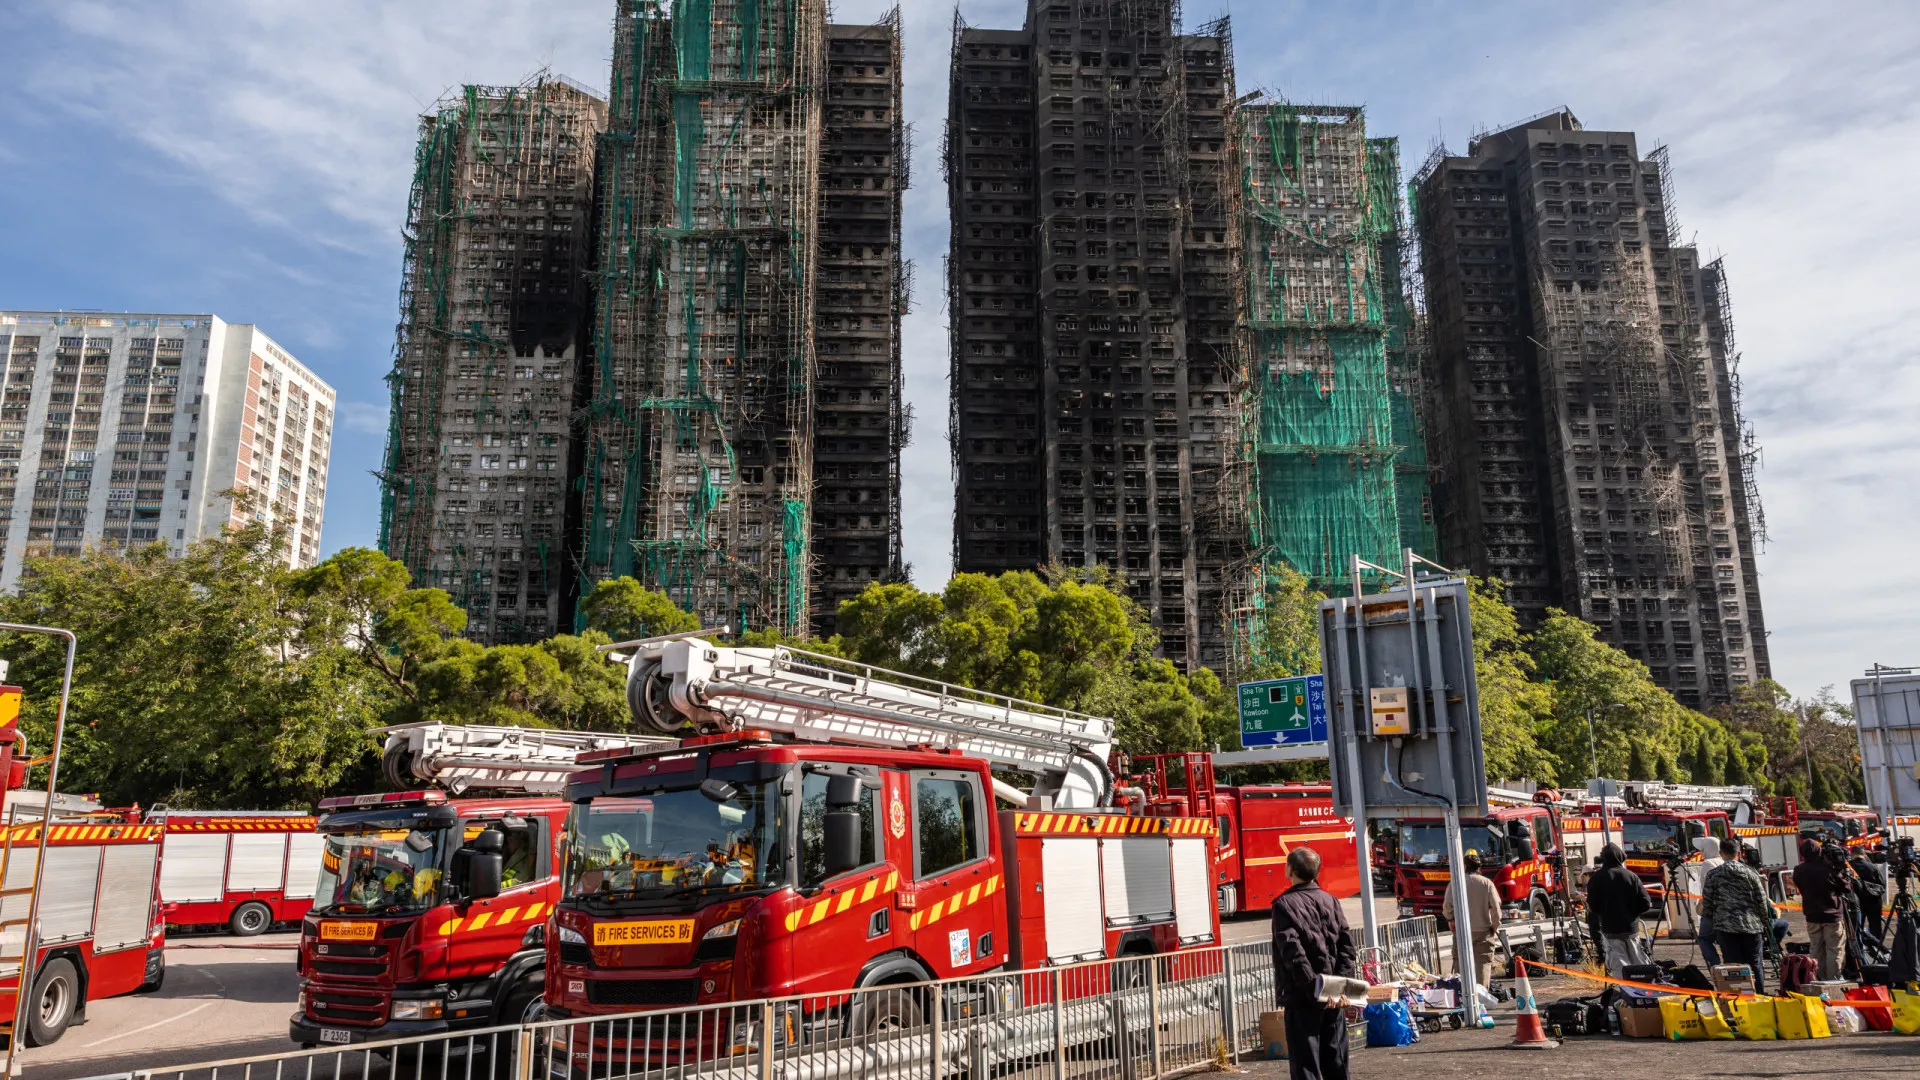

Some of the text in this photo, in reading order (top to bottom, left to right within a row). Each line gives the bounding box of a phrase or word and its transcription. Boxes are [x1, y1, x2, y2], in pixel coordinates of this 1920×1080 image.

[1255, 686, 1264, 694] Tin
[1243, 697, 1260, 708] 沙田
[1312, 703, 1322, 711] Tai
[1243, 708, 1269, 717] Kowloon
[1245, 719, 1263, 731] 九龍
[329, 926, 340, 936] FIRE
[341, 926, 366, 936] SERVICES
[597, 923, 690, 942] 消 FIRE SERVICES 防
[323, 1030, 349, 1042] F 2305
